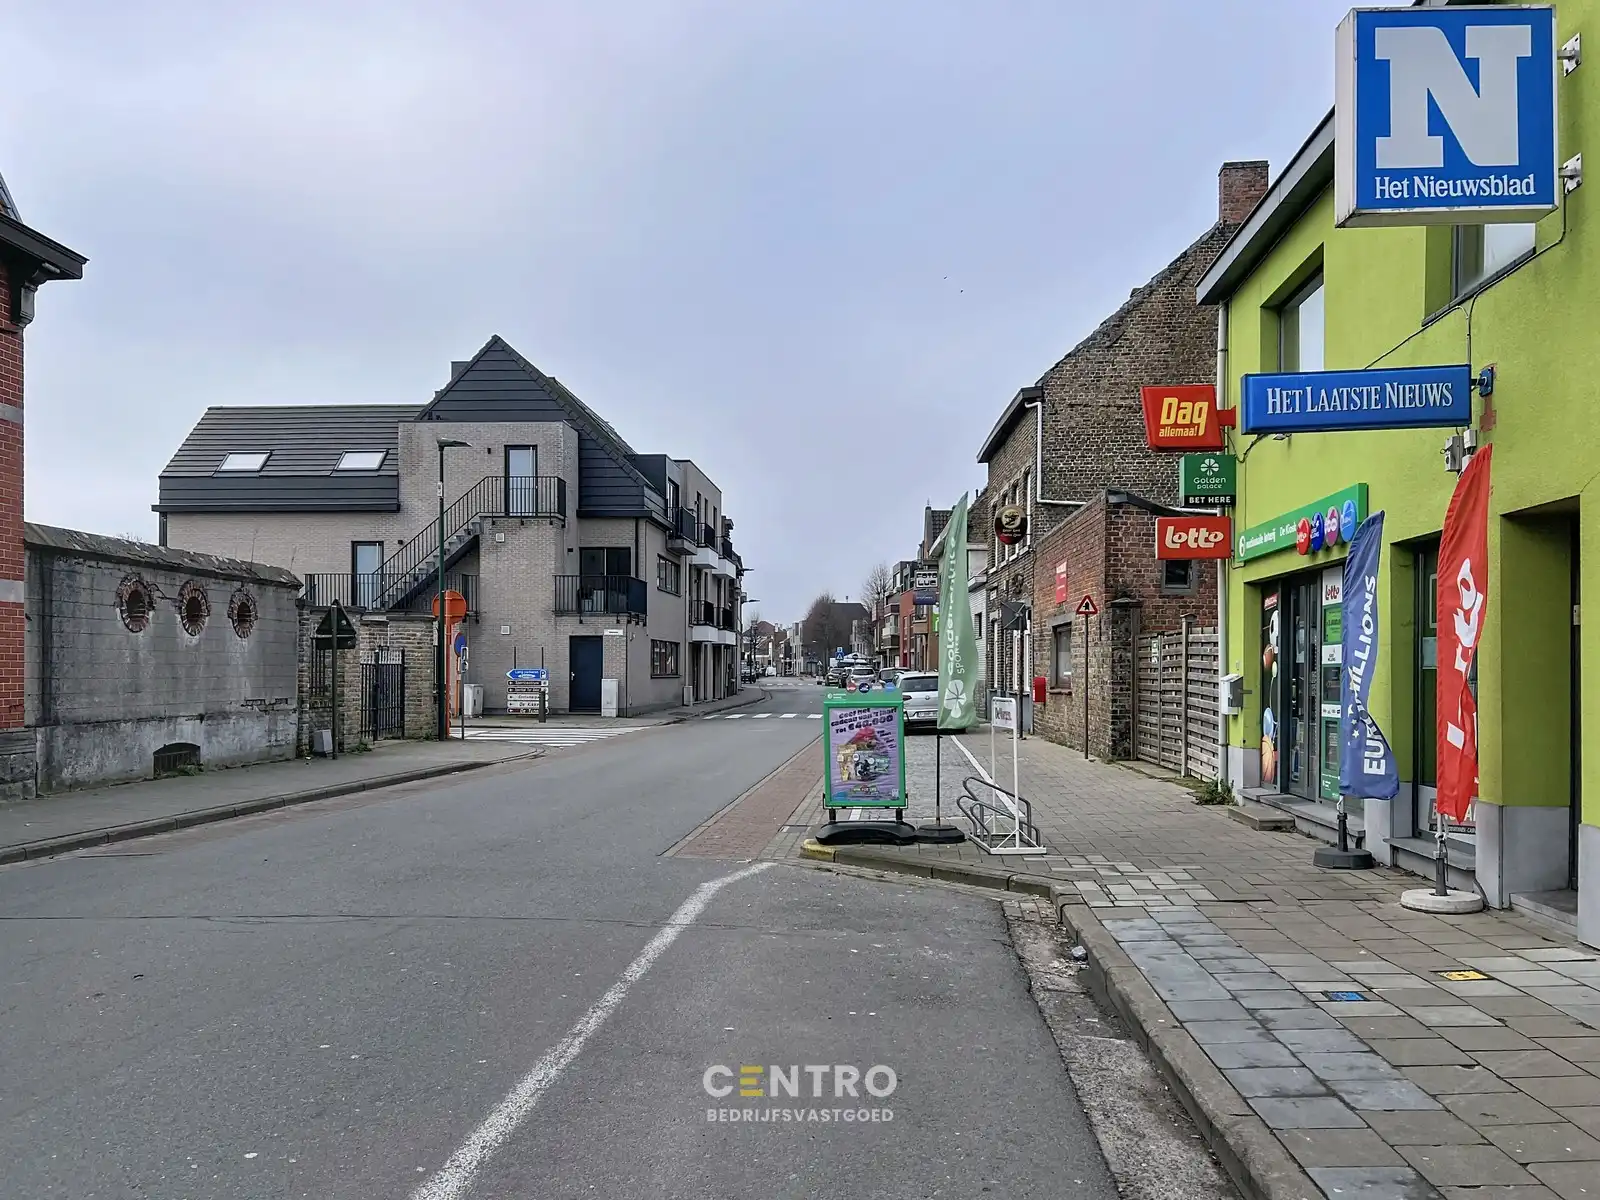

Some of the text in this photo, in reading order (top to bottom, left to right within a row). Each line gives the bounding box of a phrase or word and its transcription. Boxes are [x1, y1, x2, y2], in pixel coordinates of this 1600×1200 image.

[1375, 25, 1531, 168] N
[1375, 174, 1536, 198] Het Nieuwsblad
[1160, 397, 1209, 436] Dag
[1189, 496, 1231, 504] BET HERE
